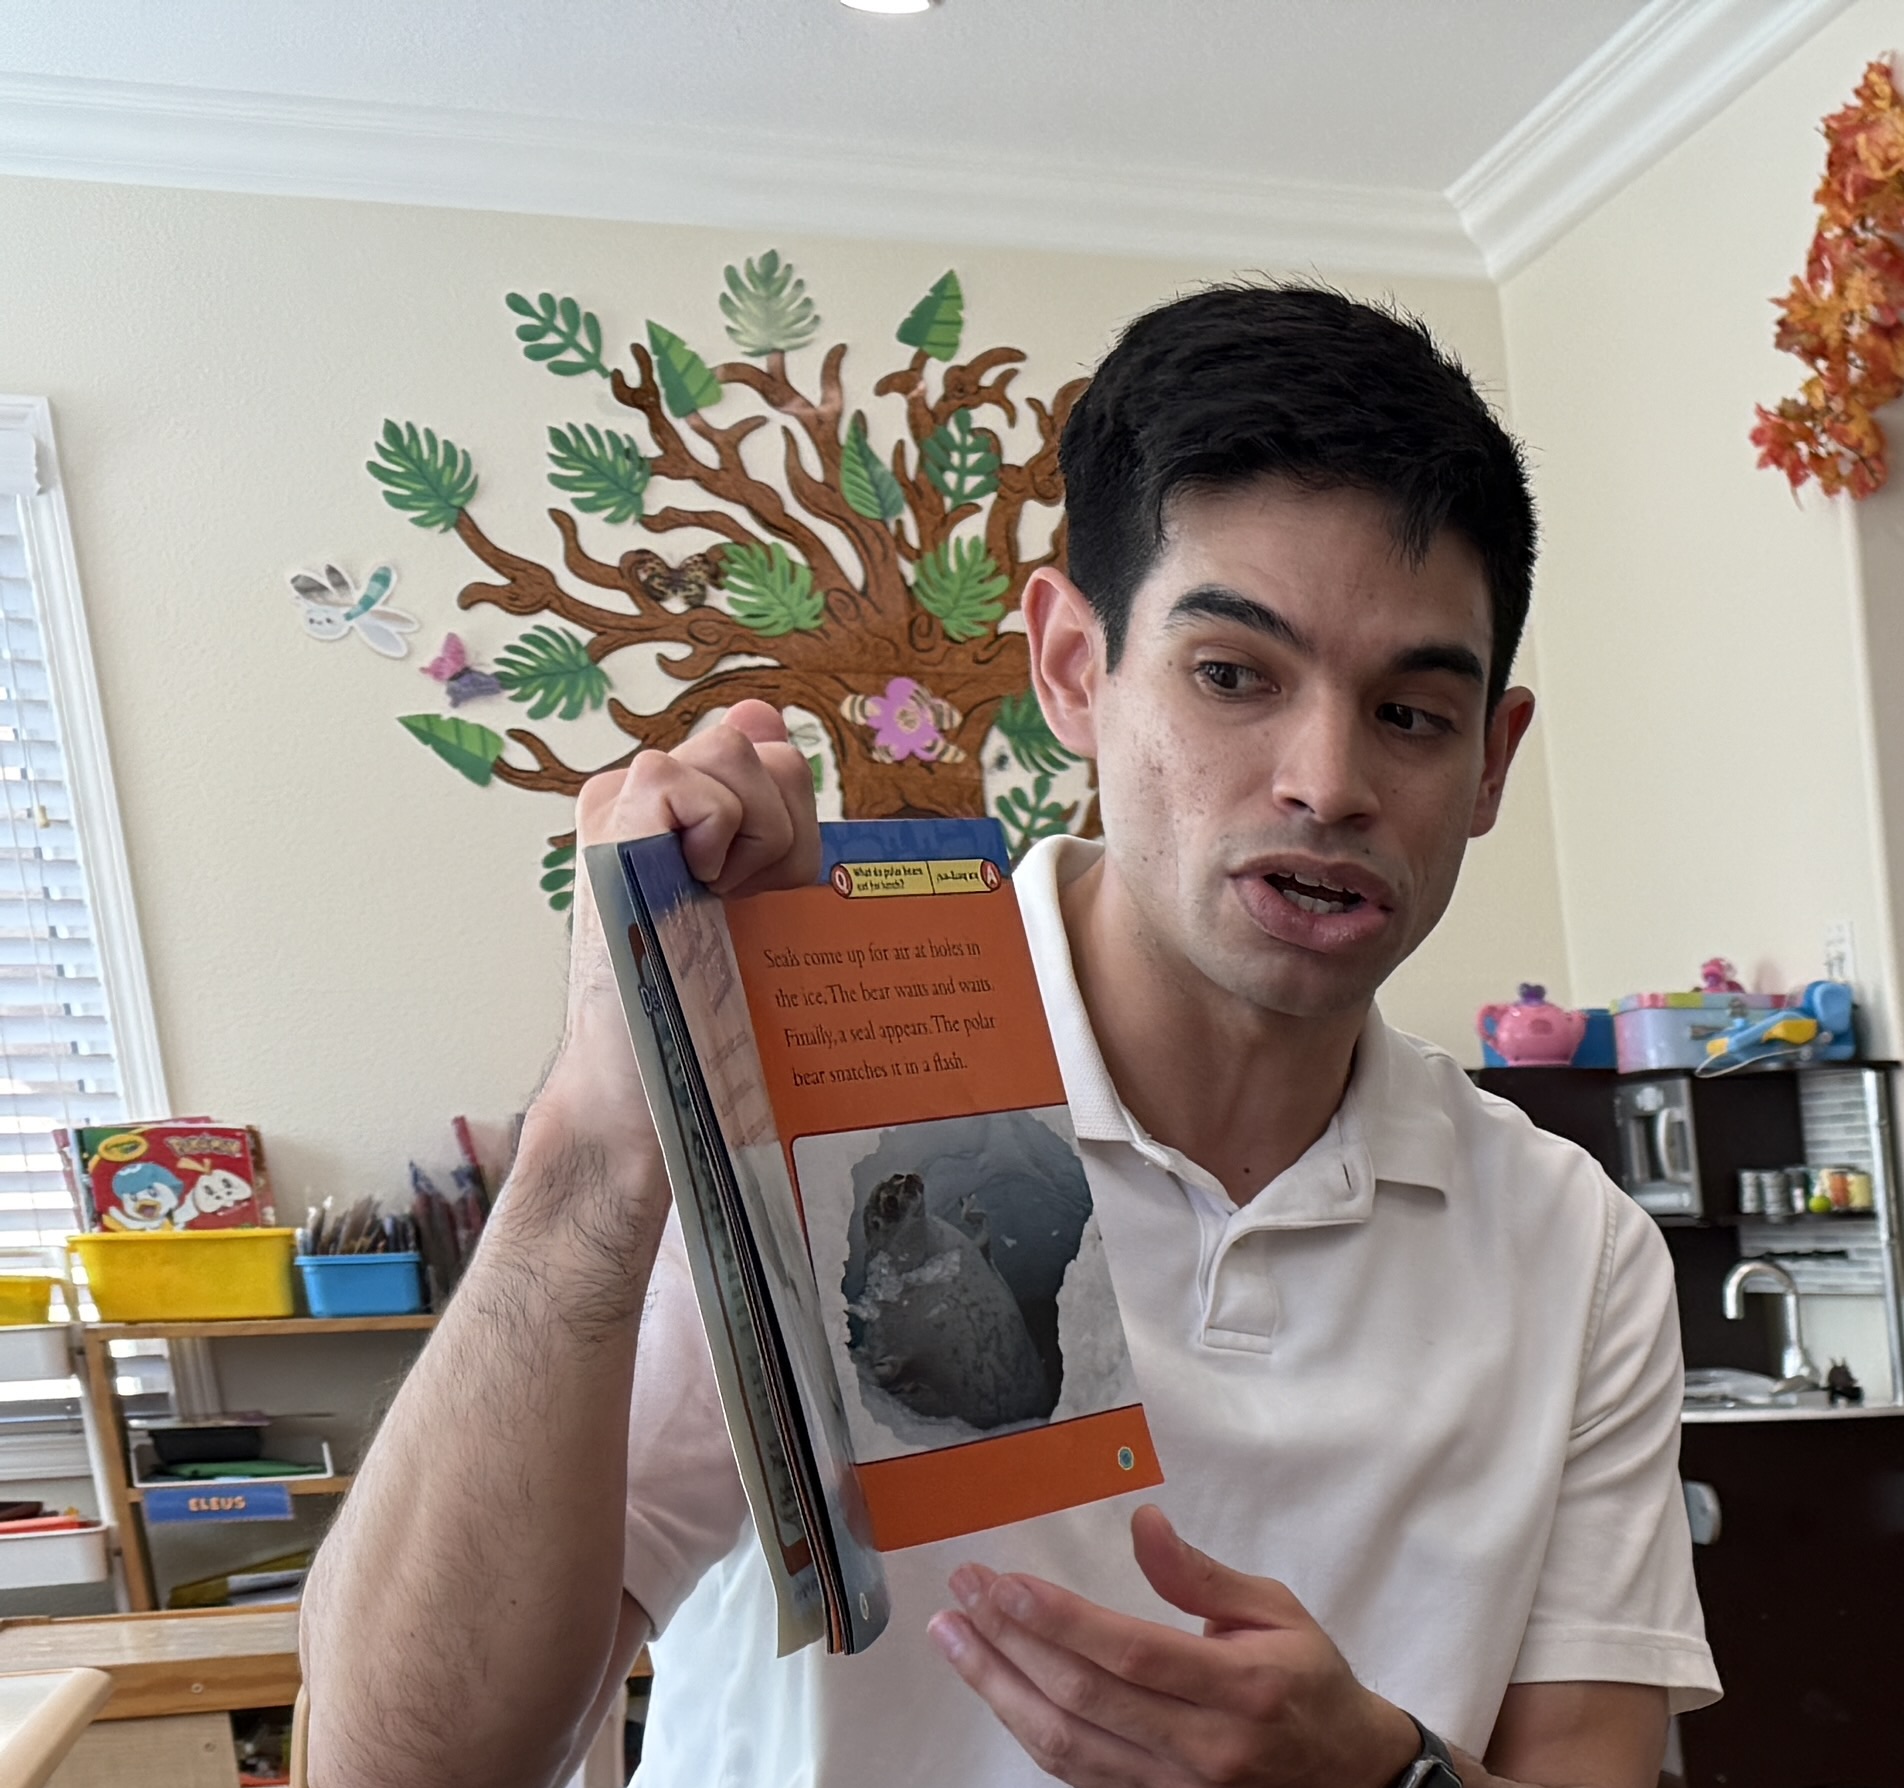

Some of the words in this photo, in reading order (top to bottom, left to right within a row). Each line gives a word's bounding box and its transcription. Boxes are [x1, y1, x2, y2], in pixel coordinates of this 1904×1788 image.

[764, 946, 800, 968] Seals
[804, 951, 843, 966] come
[848, 950, 864, 968] up
[868, 942, 890, 963] for
[894, 946, 910, 960] air
[915, 945, 928, 959] at
[928, 937, 964, 959] holes
[965, 942, 981, 957] in
[775, 988, 799, 1008] the
[803, 987, 827, 1006] ice.
[827, 984, 857, 1005] The
[860, 981, 890, 1002] bear
[895, 982, 929, 999] waits
[932, 975, 955, 995] and
[959, 977, 994, 993] waits.
[784, 1023, 838, 1049] Finally,
[840, 1030, 848, 1044] a
[850, 1020, 876, 1041] seal
[879, 1021, 931, 1045] appears.
[930, 1014, 960, 1034] The
[963, 1010, 997, 1037] polar
[792, 1067, 825, 1087] bear
[829, 1060, 887, 1083] snatches
[891, 1061, 902, 1076] it
[904, 1060, 919, 1075] in
[923, 1061, 931, 1073] a
[933, 1052, 968, 1072] flash.
